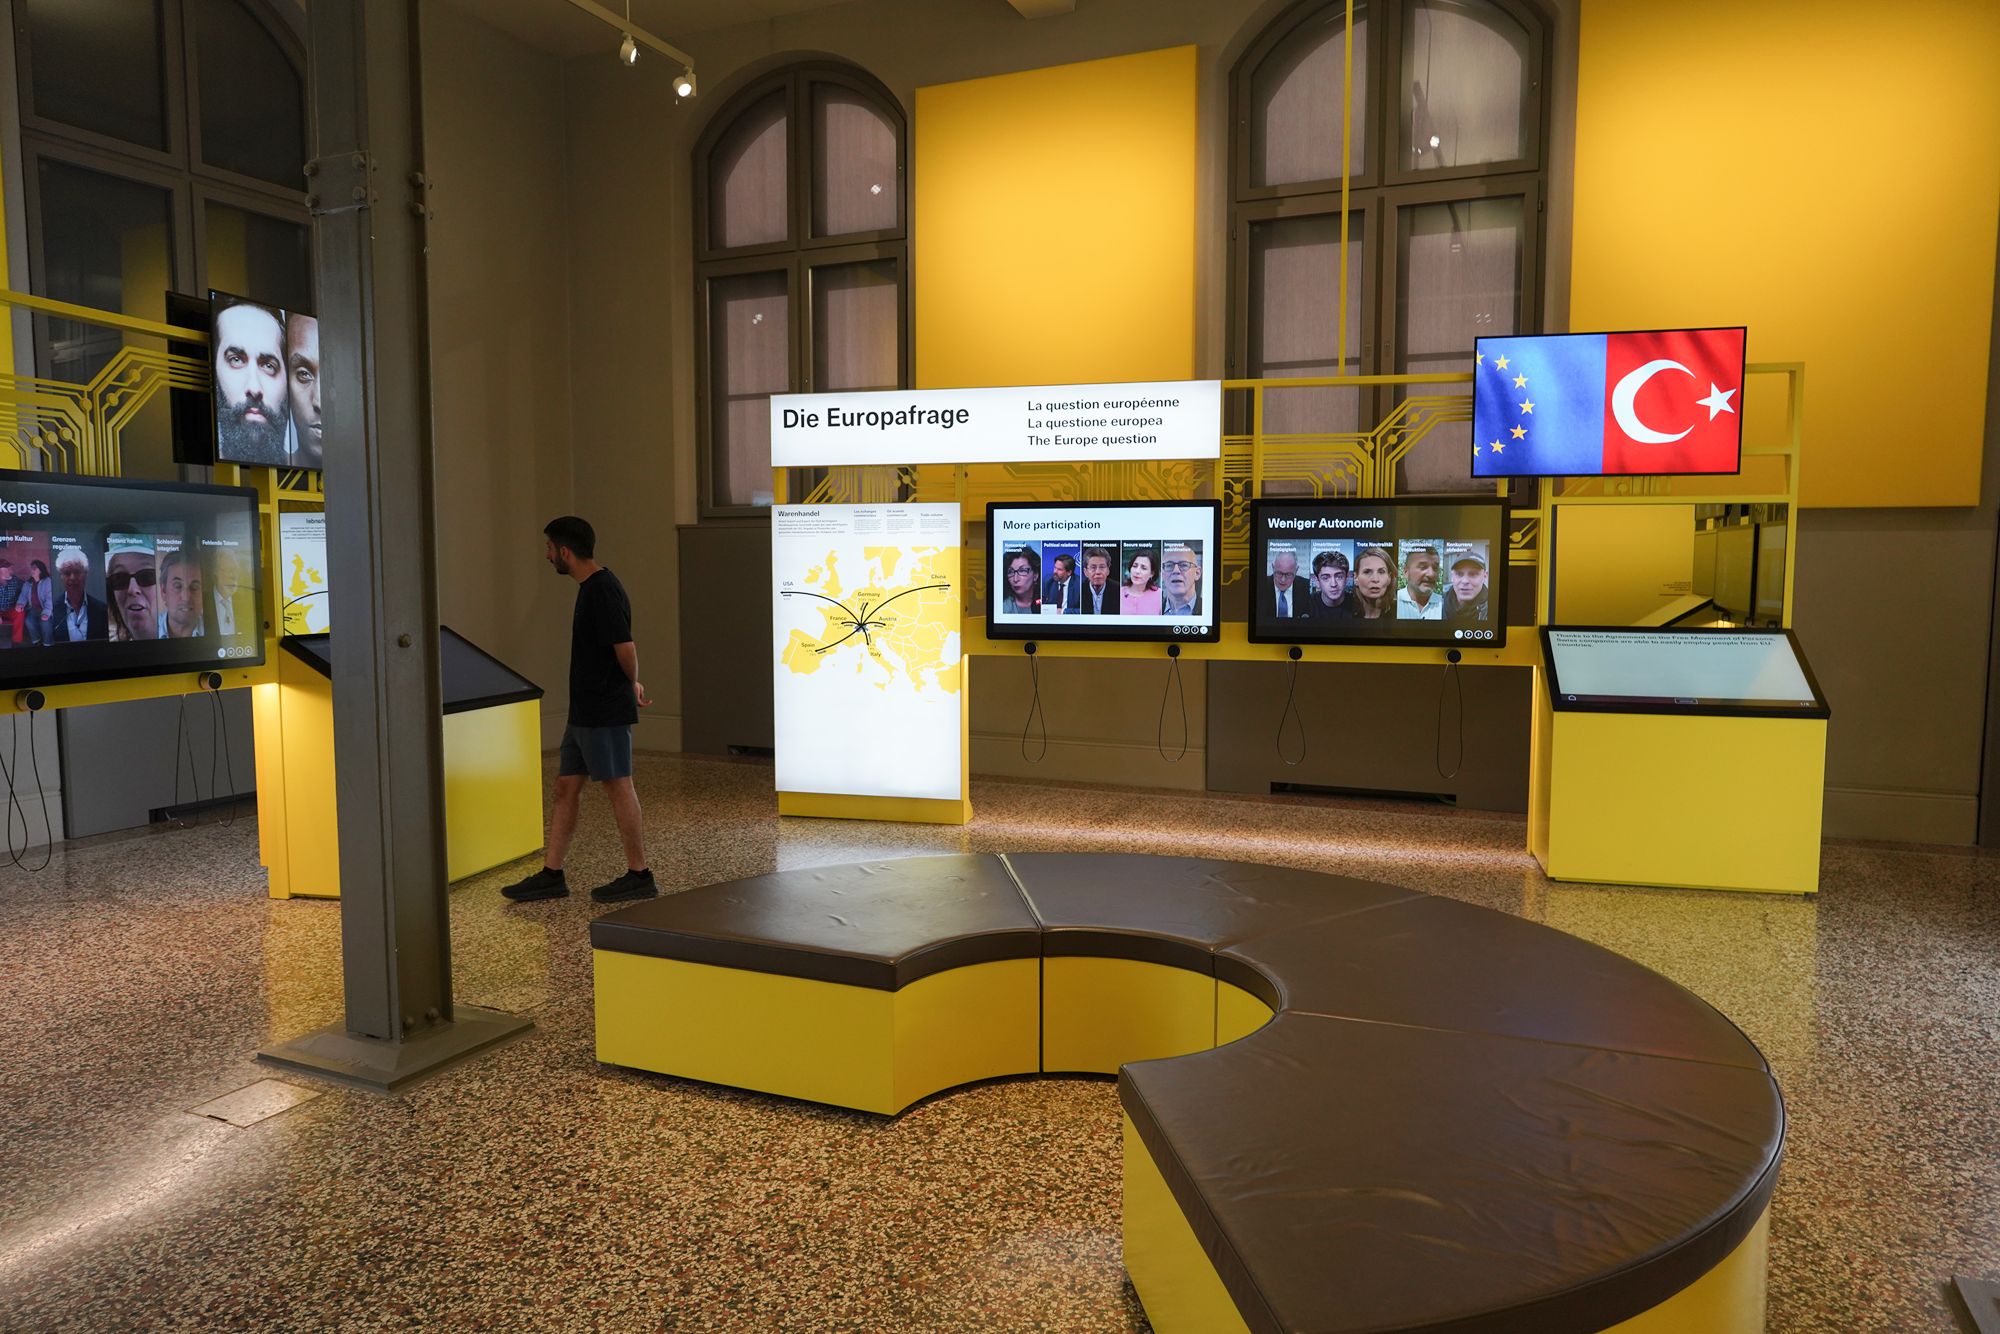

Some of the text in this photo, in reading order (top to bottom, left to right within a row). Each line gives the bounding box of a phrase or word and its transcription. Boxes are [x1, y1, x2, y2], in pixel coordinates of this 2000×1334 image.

[1028, 397, 1180, 412] La question européenne
[783, 405, 970, 431] Die Europafrage
[1028, 417, 1163, 430] La questione europea
[1027, 433, 1157, 447] The Europe question
[0, 498, 50, 516] kepsis
[1003, 519, 1101, 531] More participation
[1267, 517, 1384, 530] Weniger Autonomie
